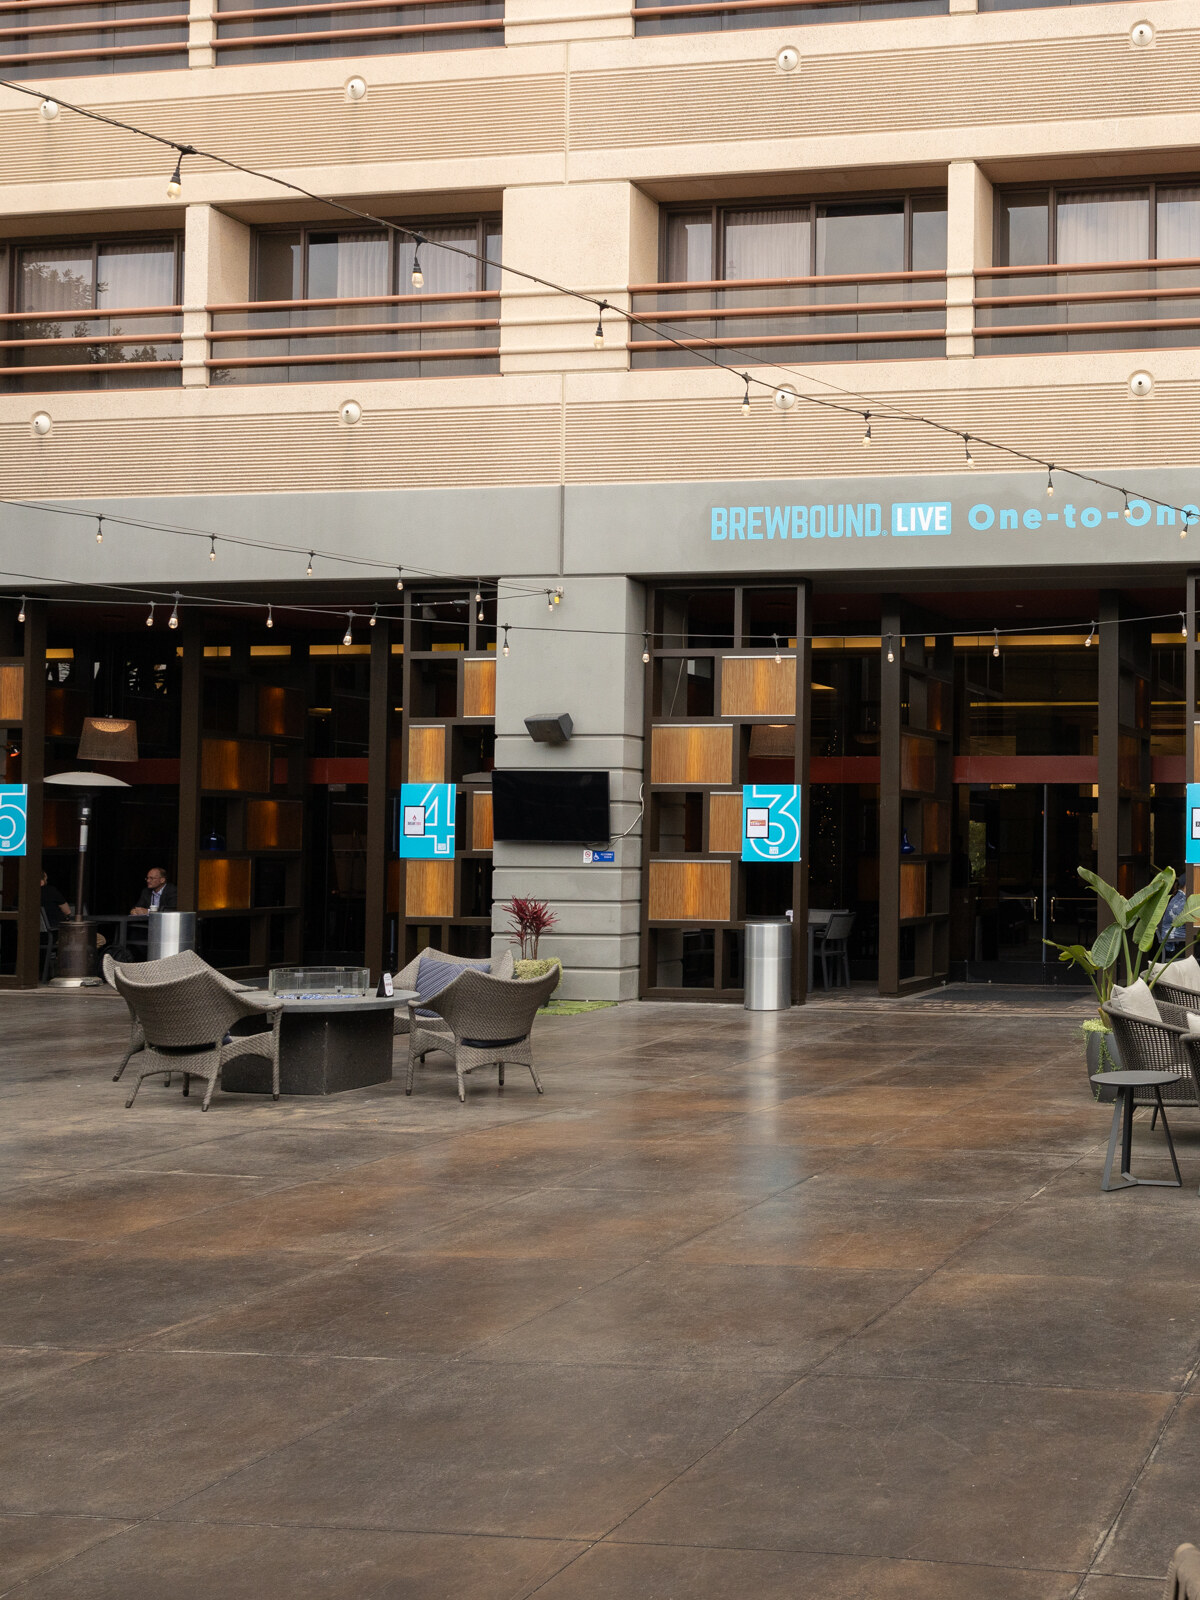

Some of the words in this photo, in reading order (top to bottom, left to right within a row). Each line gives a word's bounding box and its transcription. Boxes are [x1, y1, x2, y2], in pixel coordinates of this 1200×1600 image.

[897, 506, 947, 532] LIVE
[406, 784, 455, 854] 4
[749, 784, 800, 859] 3
